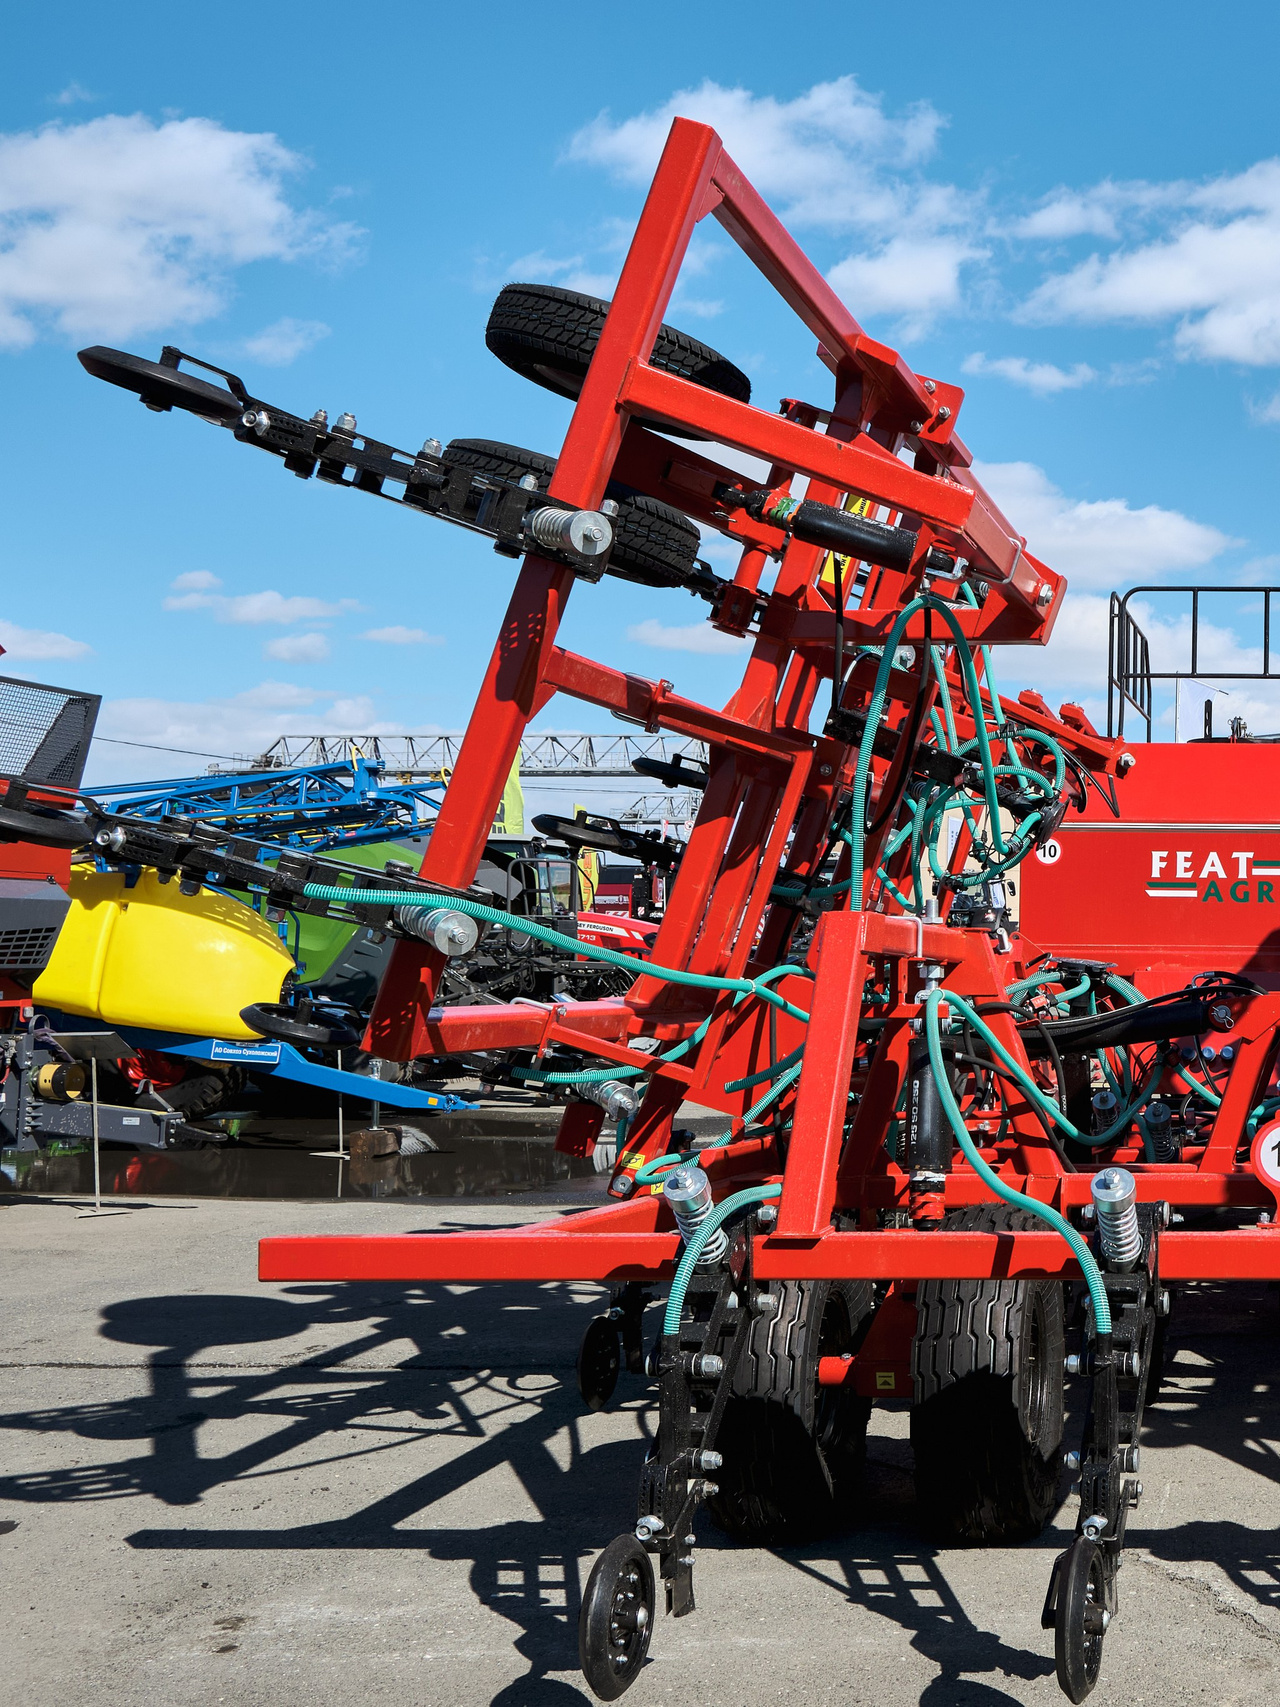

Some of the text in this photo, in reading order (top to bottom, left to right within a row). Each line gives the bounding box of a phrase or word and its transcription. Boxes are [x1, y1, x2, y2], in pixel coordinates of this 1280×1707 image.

[1041, 844, 1057, 858] 10
[1151, 850, 1254, 878] FEAT
[587, 924, 614, 932] FERGUSON
